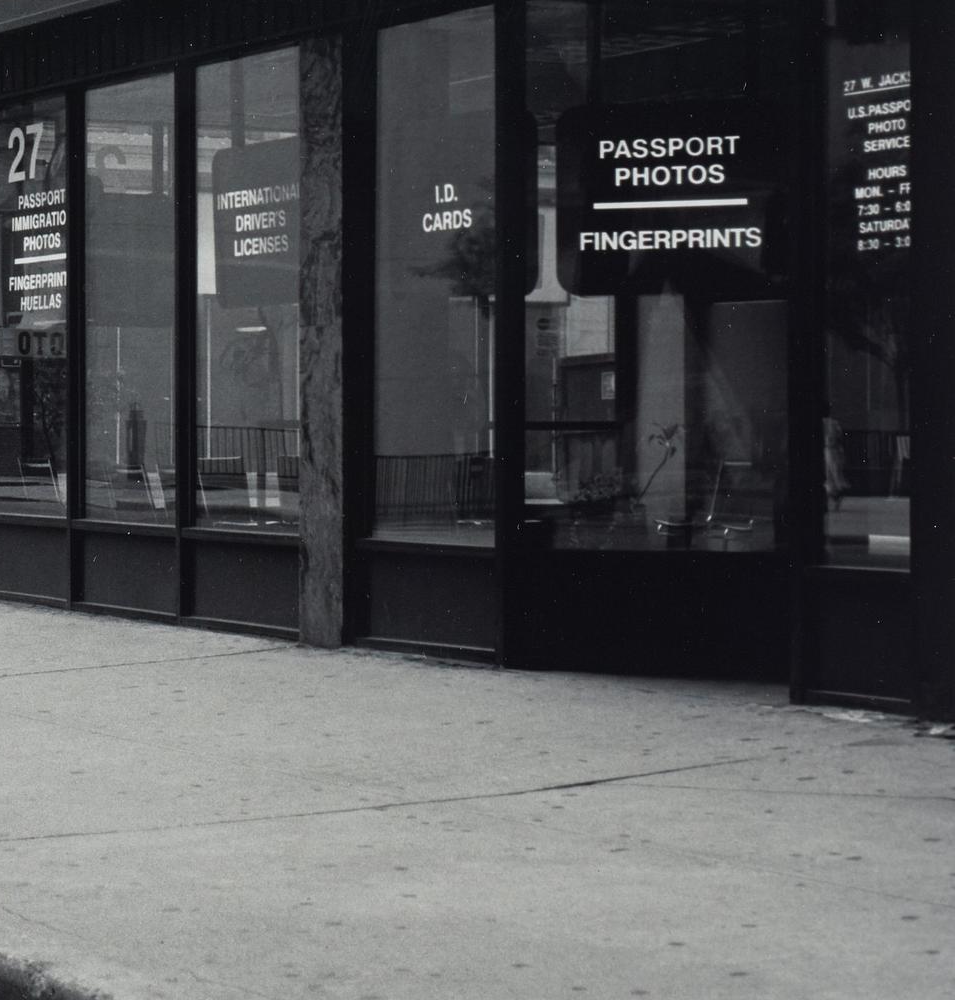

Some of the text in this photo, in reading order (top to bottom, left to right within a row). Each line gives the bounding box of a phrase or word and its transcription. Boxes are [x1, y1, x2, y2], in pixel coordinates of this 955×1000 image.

[844, 80, 855, 92] 27
[868, 119, 905, 134] PHOTO
[8, 122, 43, 183] 27
[599, 136, 740, 159] PASSPORT
[864, 136, 911, 152] SERVICE
[615, 164, 725, 187] PHOTOS
[868, 165, 906, 180] HOURS
[18, 188, 66, 210] PASSPORT
[435, 184, 458, 204] I.D.
[857, 204, 880, 216] 7:30
[11, 210, 67, 232] IMMIGRATIO
[236, 210, 285, 232] DRIVER'S
[422, 209, 473, 233] CARDS
[859, 218, 911, 233] SATURDA
[23, 232, 61, 252] PHOTOS
[234, 235, 288, 257] LICENSES
[579, 227, 762, 252] FINGERPRINTS
[20, 293, 62, 311] HUELLAS
